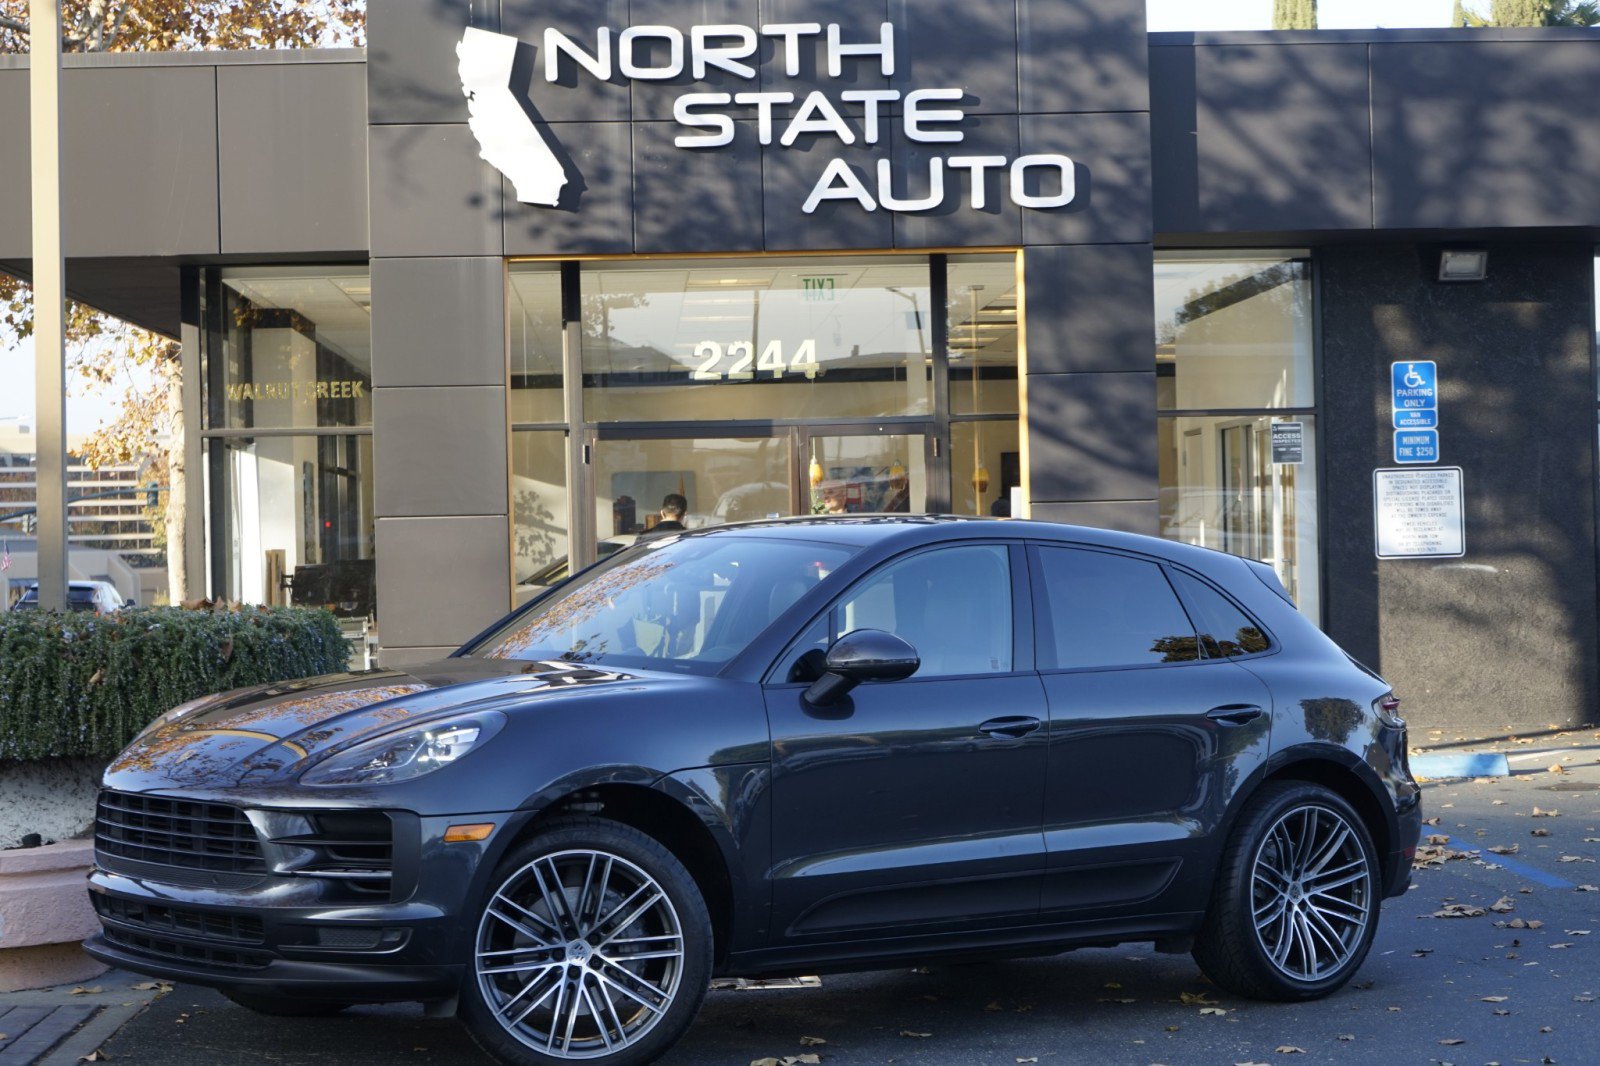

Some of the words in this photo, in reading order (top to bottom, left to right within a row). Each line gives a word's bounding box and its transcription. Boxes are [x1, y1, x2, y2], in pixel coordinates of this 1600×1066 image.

[544, 22, 895, 82] NORTH
[673, 88, 965, 148] STATE
[802, 153, 1076, 213] AUTO
[692, 339, 820, 381] 2244
[226, 382, 300, 402] WALNUT
[304, 380, 364, 401] CREEK
[1396, 388, 1434, 397] PARKING
[1404, 399, 1426, 408] ONLY
[1399, 447, 1413, 456] FINE
[1416, 446, 1434, 456] $250
[1402, 436, 1430, 445] MINIMUM
